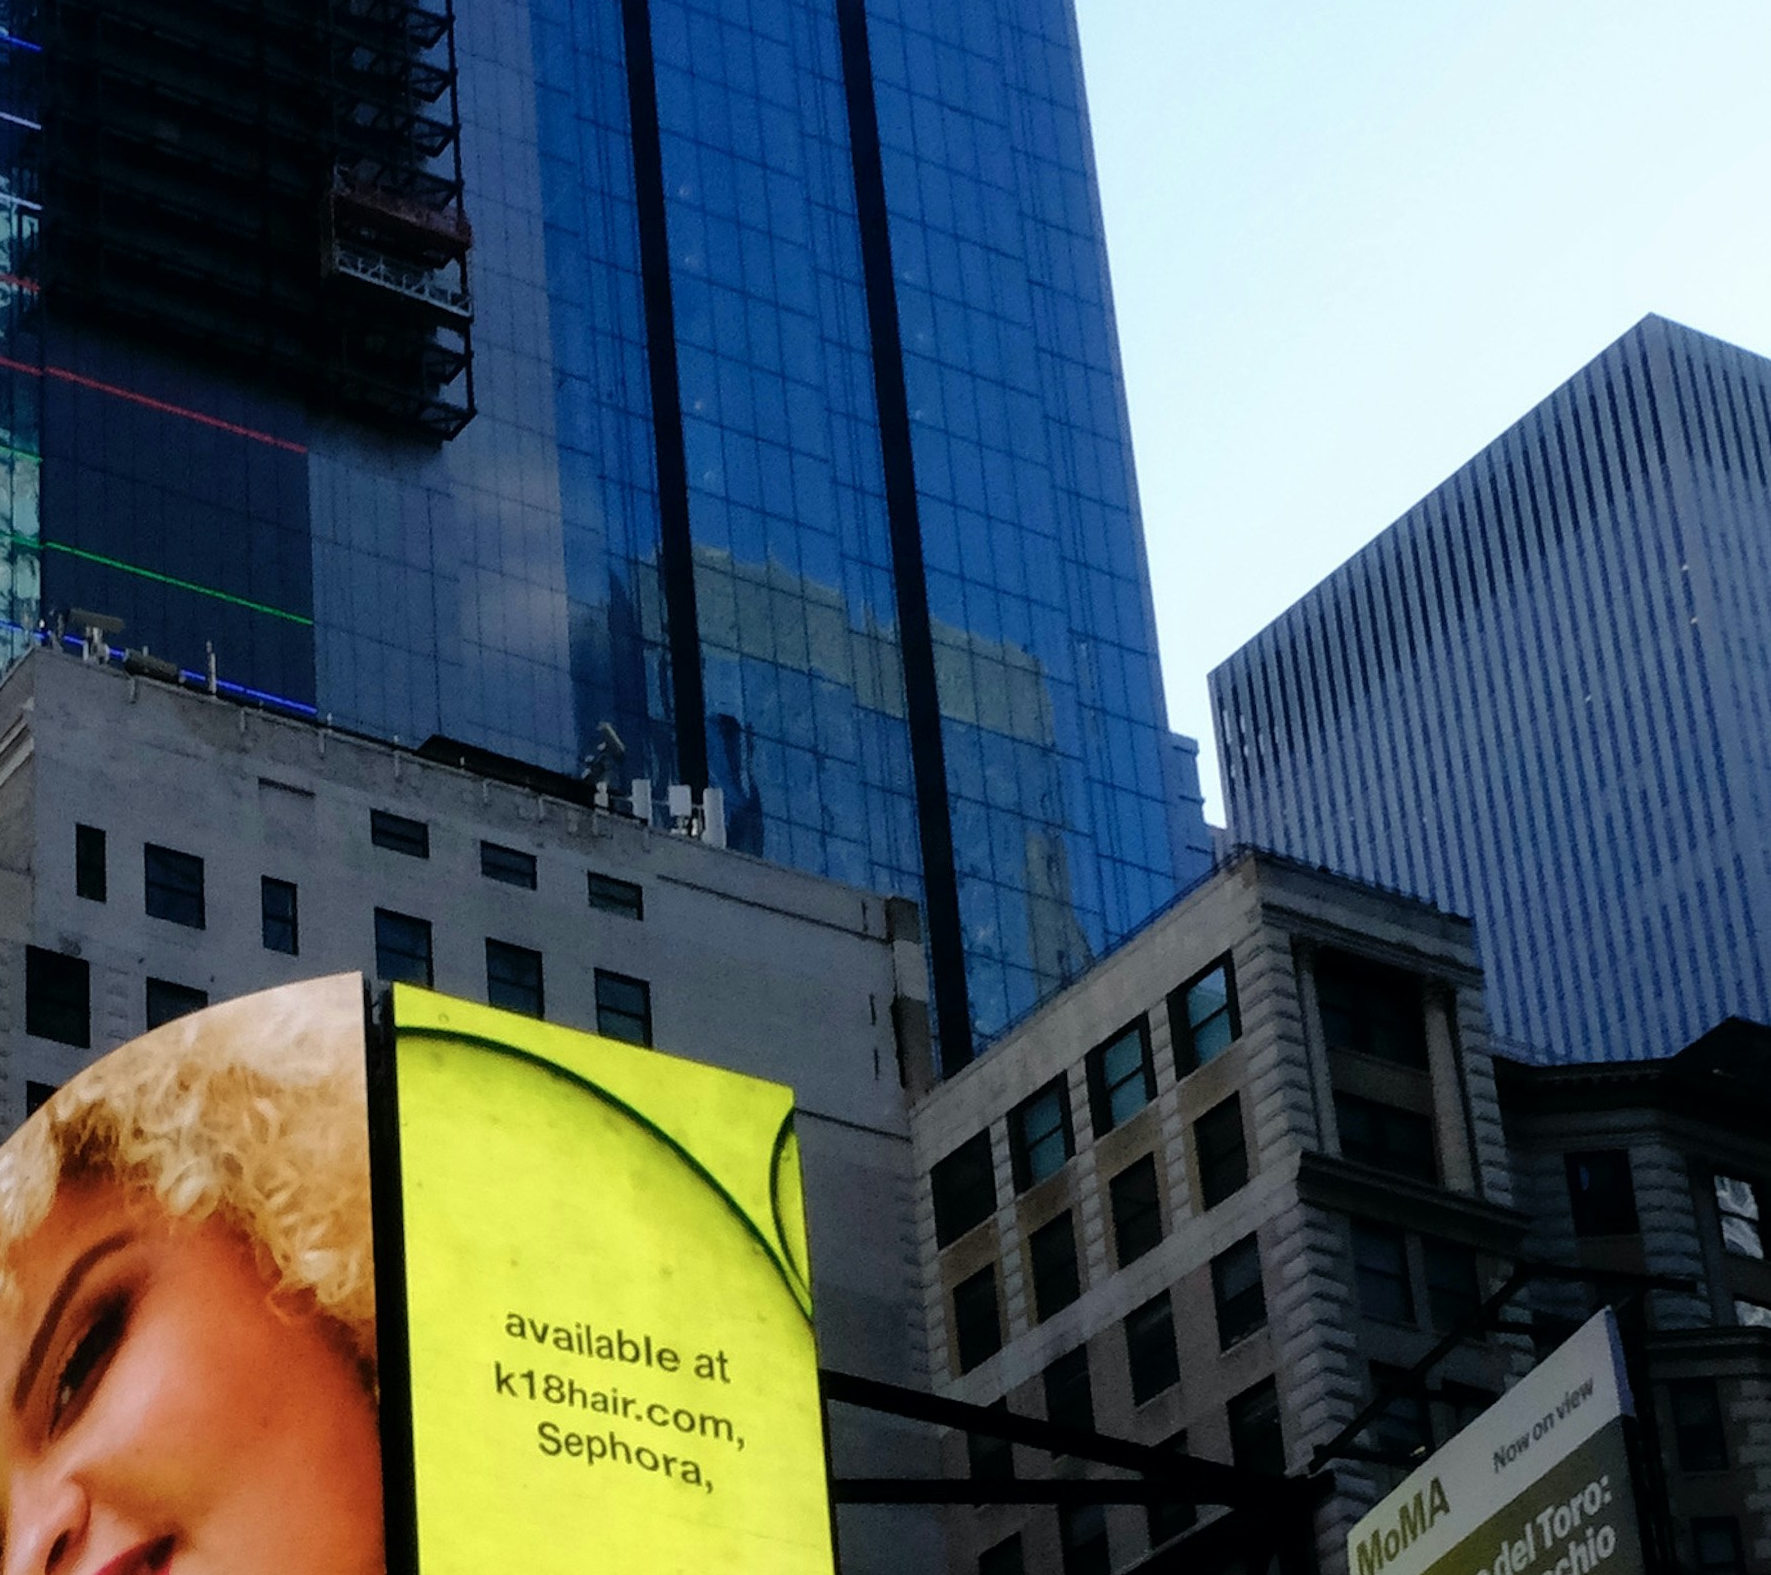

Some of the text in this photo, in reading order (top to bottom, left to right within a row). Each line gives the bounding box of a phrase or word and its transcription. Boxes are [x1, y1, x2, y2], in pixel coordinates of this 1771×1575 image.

[505, 1312, 730, 1384] available at
[494, 1361, 745, 1452] k18hair.com,
[1493, 1378, 1595, 1473] Now on view
[537, 1421, 713, 1494] Sephora,
[1536, 1475, 1613, 1549] Toro:
